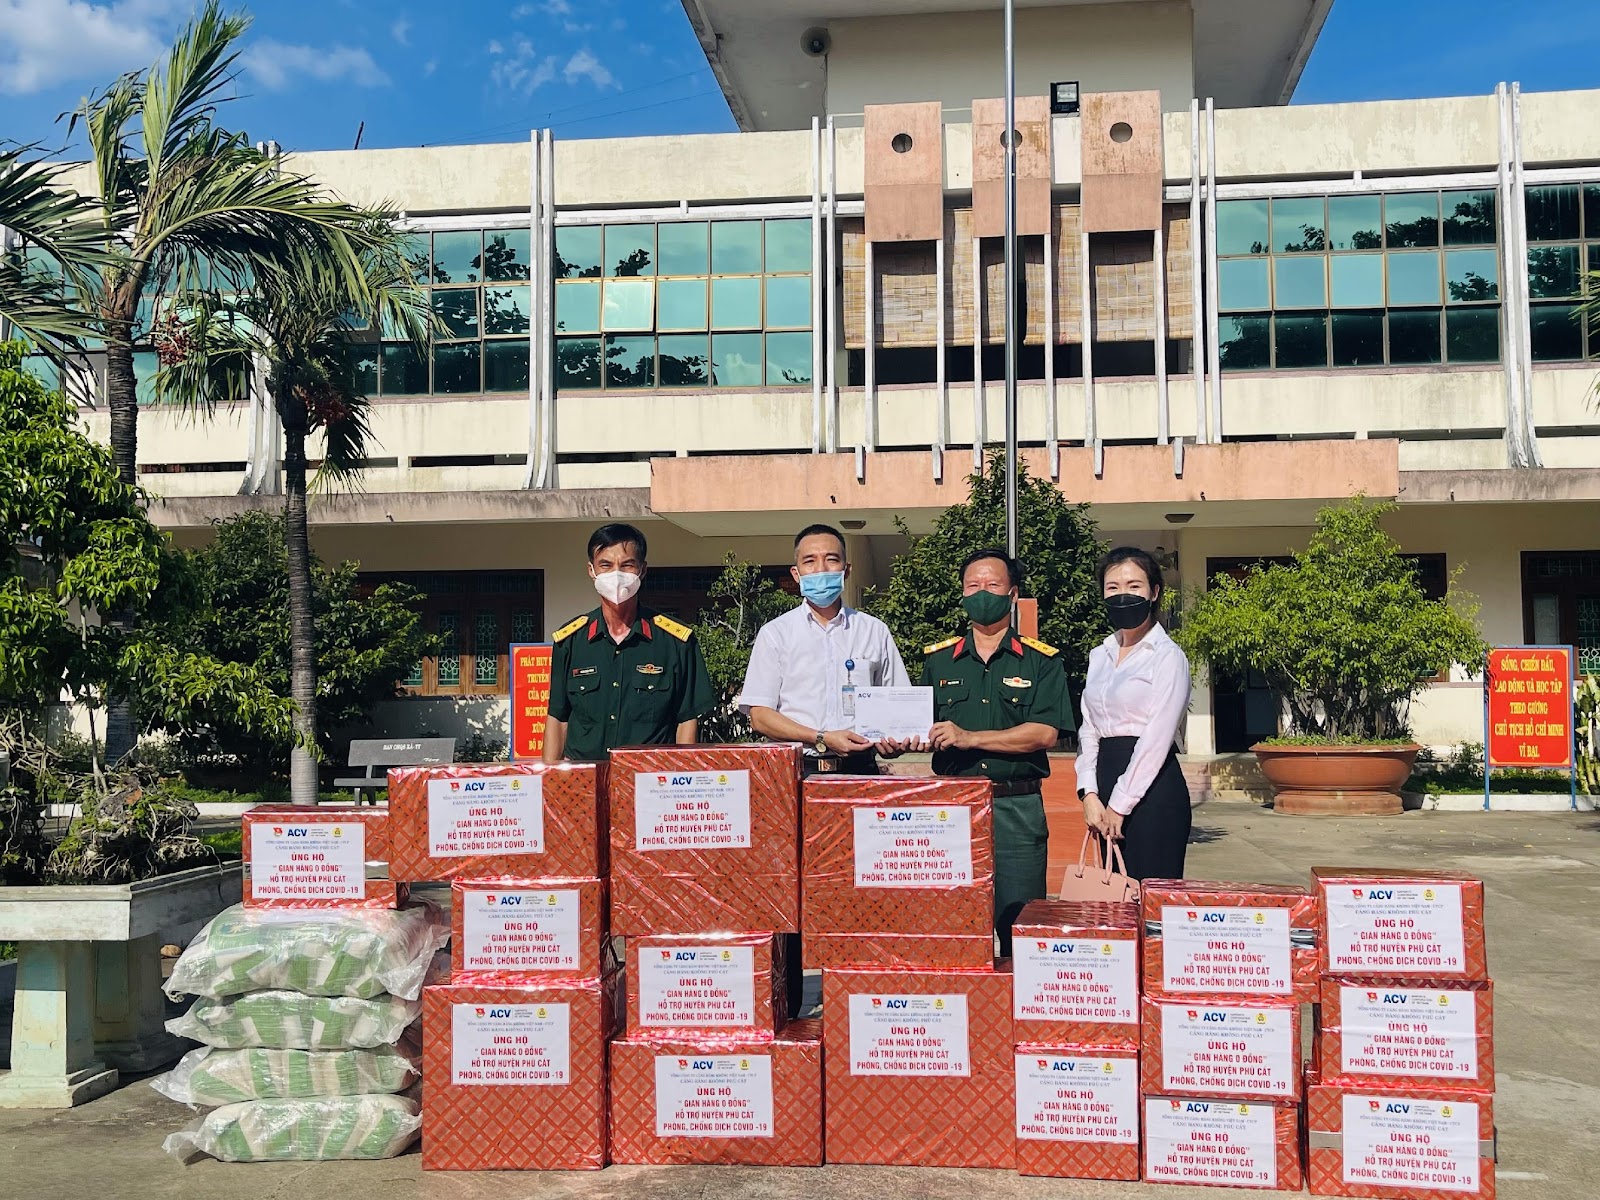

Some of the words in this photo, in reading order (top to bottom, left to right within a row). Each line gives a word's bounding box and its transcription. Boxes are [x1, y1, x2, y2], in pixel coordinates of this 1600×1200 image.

[536, 657, 548, 666] HUY
[1520, 654, 1539, 671] CHIẾN
[1508, 678, 1525, 694] ĐỘNG
[1526, 678, 1535, 692] VÀ
[1536, 681, 1549, 695] HỌC
[1550, 678, 1562, 694] TẬP
[1510, 702, 1526, 714] THEO
[1495, 718, 1507, 736] CHỦ
[1509, 724, 1524, 738] TỊCH
[1525, 718, 1534, 736] HỒ
[1535, 720, 1546, 736] CHÍ
[1548, 724, 1564, 736] MINH
[465, 782, 485, 791] ACV
[672, 777, 692, 785] ACV
[469, 806, 487, 816] ỦNG
[490, 806, 503, 817] HỘ
[676, 800, 694, 810] ỦNG
[697, 801, 709, 812] HỘ
[474, 818, 491, 827] HÀNG
[891, 813, 912, 821] ACV
[655, 823, 664, 833] HỖ
[666, 825, 678, 834] TRỢ
[681, 823, 702, 834] HUYỆN
[704, 823, 717, 832] PHÙ
[720, 823, 732, 831] CÁT
[895, 837, 914, 847] ỦNG
[917, 837, 930, 848] HỘ
[291, 852, 309, 861] ỦNG
[312, 852, 324, 863] HỘ
[862, 873, 886, 882] PHÒNG,
[889, 871, 911, 881] CHỐNG
[914, 873, 930, 882] DỊCH
[258, 886, 282, 894] PHÒNG,
[284, 884, 306, 893] CHỐNG
[308, 887, 324, 895] DỊCH
[1369, 891, 1393, 899] ACV
[501, 896, 521, 905] ACV
[1203, 913, 1226, 922] ACV
[504, 921, 522, 930] ỦNG
[526, 921, 538, 932] HỘ
[1374, 917, 1396, 928] ỦNG
[1400, 918, 1414, 930] HỘ
[1360, 932, 1378, 940] GIAN
[1381, 930, 1401, 940] HÀNG
[1052, 944, 1074, 953] ACV
[1207, 939, 1228, 950] ỦNG
[1231, 940, 1245, 952] HỘ
[676, 952, 696, 960] ACV
[1057, 969, 1076, 980] ỦNG
[1080, 970, 1093, 982] HỘ
[679, 976, 697, 986] ỦNG
[701, 977, 713, 988] HỘ
[887, 1000, 908, 1008] ACV
[1383, 994, 1407, 1004] ACV
[490, 1010, 511, 1018] ACV
[1203, 1012, 1226, 1022] ACV
[891, 1025, 910, 1035] ỦNG
[913, 1025, 926, 1037] HỘ
[1388, 1021, 1409, 1032] ỦNG
[1413, 1022, 1428, 1034] HỘ
[494, 1034, 512, 1044] ỦNG
[516, 1035, 528, 1046] HỘ
[896, 1037, 914, 1046] HÀNG
[1208, 1039, 1228, 1050] ỦNG
[1232, 1040, 1246, 1052] HỘ
[693, 1061, 713, 1069] ACV
[1053, 1062, 1075, 1071] ACV
[459, 1070, 484, 1080] PHÒNG,
[486, 1069, 508, 1079] CHỐNG
[511, 1071, 527, 1080] DỊCH
[1170, 1075, 1198, 1086] PHÒNG,
[1200, 1075, 1225, 1086] CHỐNG
[1228, 1079, 1245, 1089] DỊCH
[1248, 1080, 1270, 1088] COVID
[1273, 1081, 1286, 1089] -19
[697, 1086, 715, 1096] ỦNG
[719, 1086, 731, 1097] HỘ
[1057, 1088, 1077, 1099] ỦNG
[1080, 1089, 1094, 1101] HỘ
[1186, 1103, 1209, 1113] ACV
[1386, 1103, 1410, 1114] ACV
[676, 1109, 684, 1119] HỖ
[687, 1111, 699, 1120] TRỢ
[702, 1110, 723, 1121] HUYỆN
[726, 1110, 739, 1119] PHÙ
[741, 1110, 754, 1119] CÁT
[1034, 1110, 1044, 1121] HỖ
[1047, 1113, 1060, 1124] TRỢ
[1062, 1113, 1085, 1125] HUYỆN
[1088, 1114, 1102, 1124] PHÙ
[1104, 1115, 1118, 1124] CÁT
[1191, 1129, 1211, 1141] ỦNG
[1215, 1131, 1229, 1144] HỘ
[1390, 1130, 1412, 1142] ỦNG
[1416, 1133, 1430, 1146] HỘ
